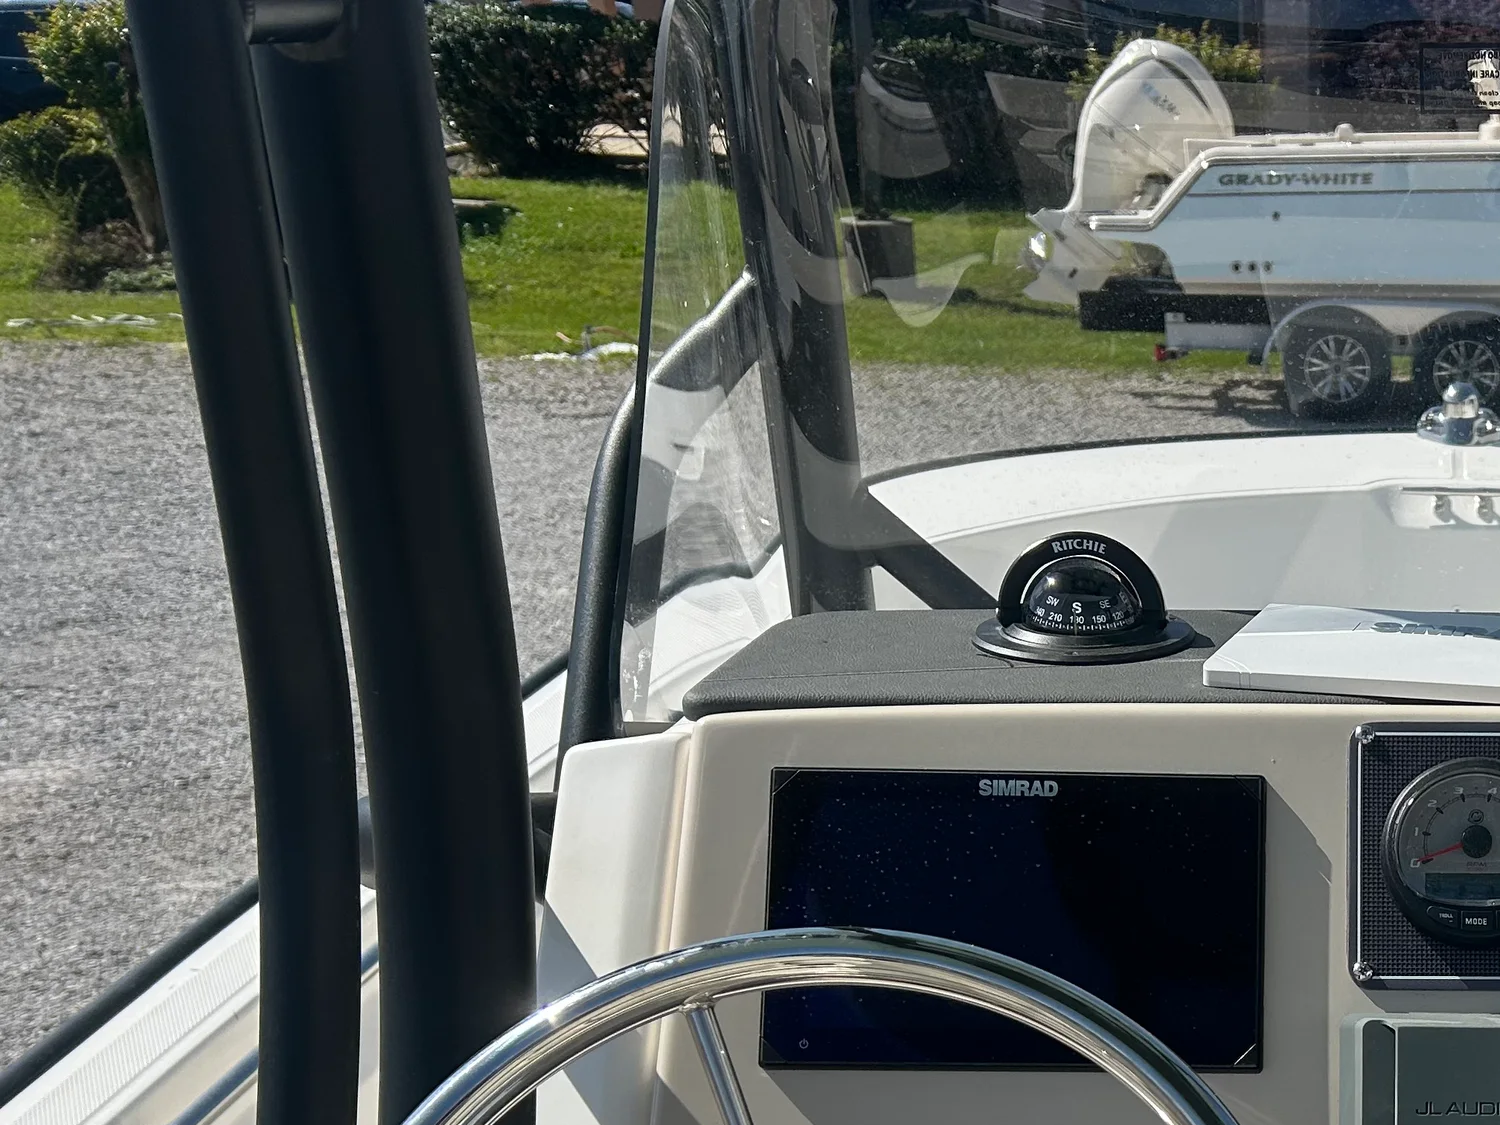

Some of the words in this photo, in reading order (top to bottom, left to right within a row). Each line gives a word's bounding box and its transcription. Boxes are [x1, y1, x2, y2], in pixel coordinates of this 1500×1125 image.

[1218, 172, 1374, 185] GRADY-WHITE
[1051, 539, 1107, 554] RITCHIE
[1046, 596, 1060, 607] SW
[1072, 602, 1082, 614] S
[1099, 600, 1111, 609] SE
[1048, 612, 1063, 622] 210
[1092, 615, 1106, 623] 150
[978, 778, 1058, 797] SIMRAD
[1414, 827, 1419, 836] 1
[1415, 1101, 1442, 1116] JL
